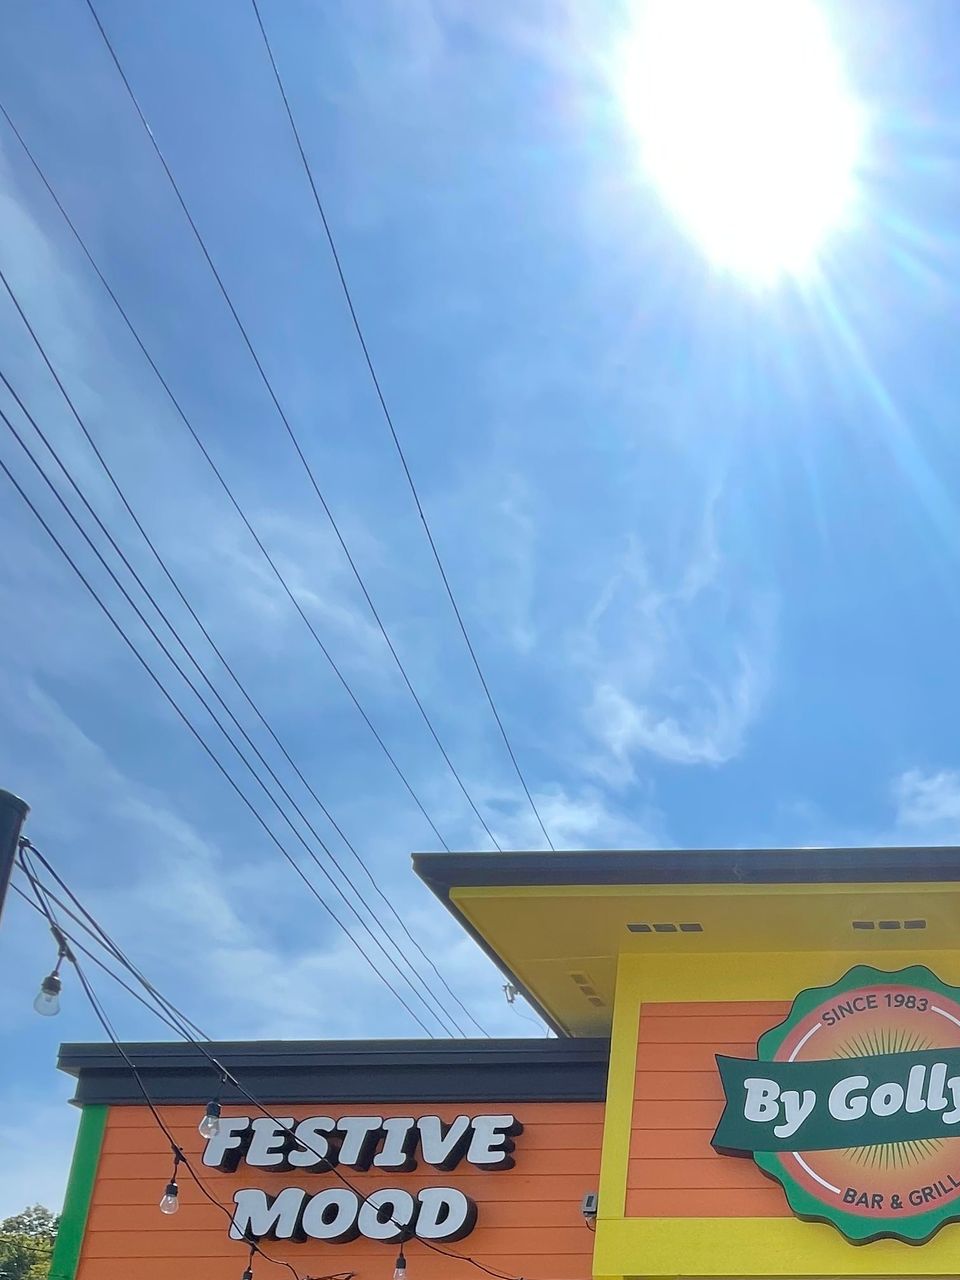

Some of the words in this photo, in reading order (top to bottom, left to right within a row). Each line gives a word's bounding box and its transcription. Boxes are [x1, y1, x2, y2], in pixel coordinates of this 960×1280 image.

[821, 993, 878, 1026] SINCE
[884, 993, 929, 1012] 1983
[743, 1077, 817, 1139] By
[201, 1114, 517, 1168] FESTIVE
[228, 1187, 470, 1240] MOOD
[843, 1187, 884, 1210] BAR
[890, 1194, 904, 1210] &
